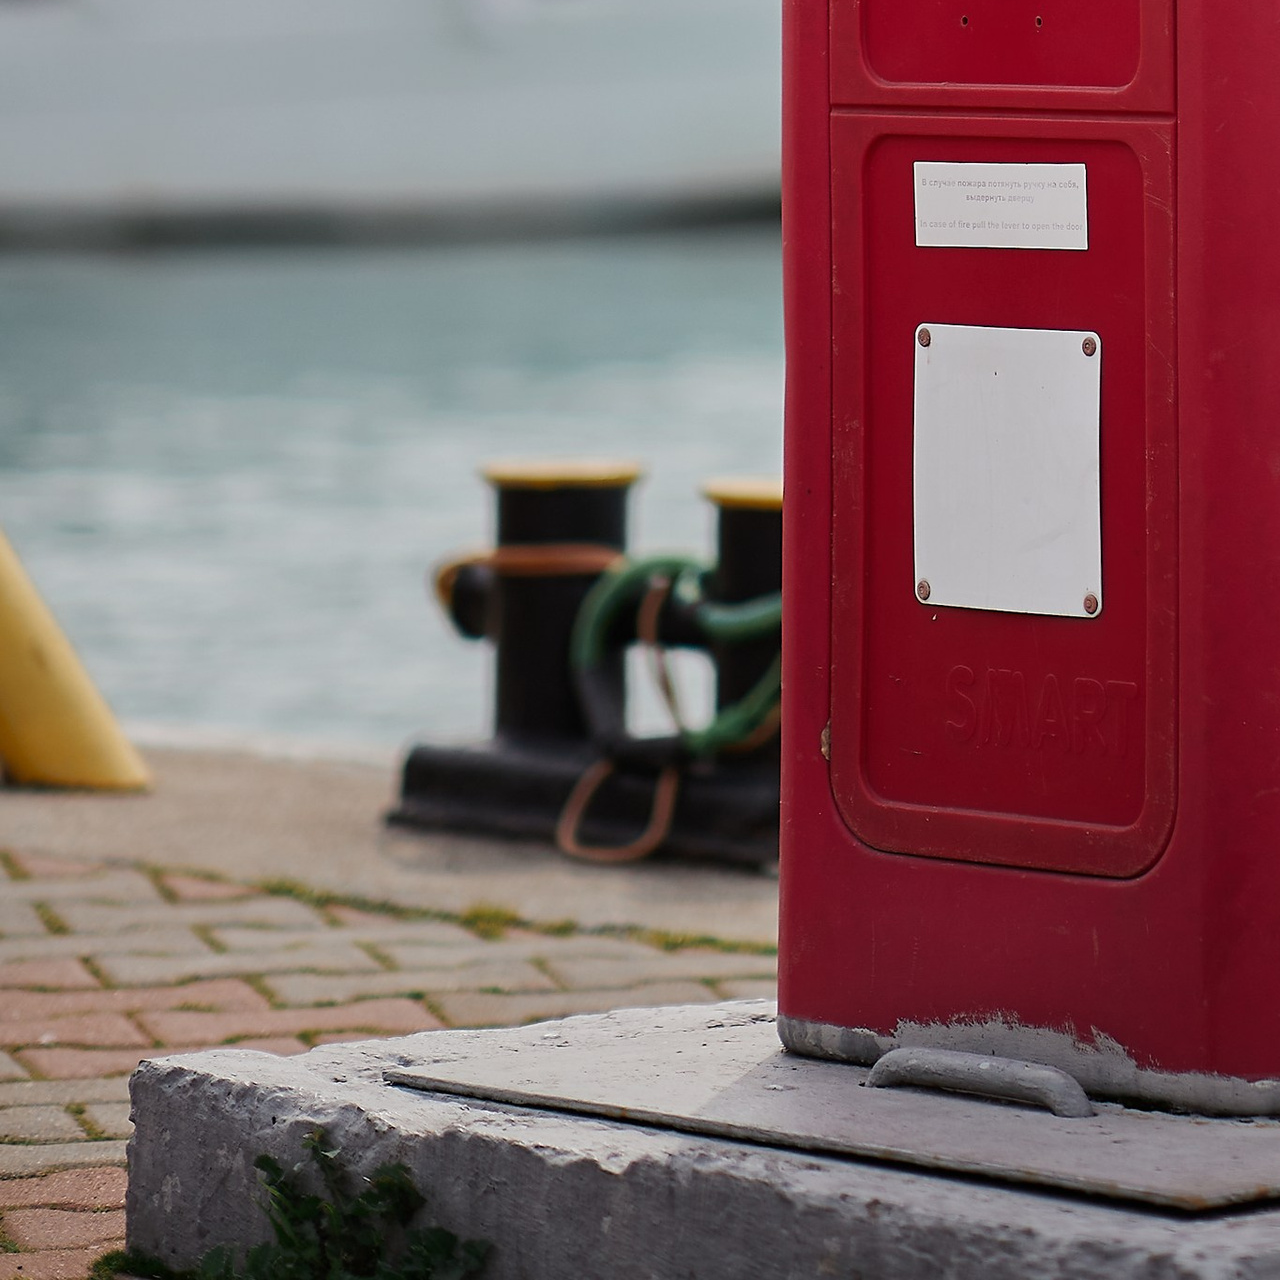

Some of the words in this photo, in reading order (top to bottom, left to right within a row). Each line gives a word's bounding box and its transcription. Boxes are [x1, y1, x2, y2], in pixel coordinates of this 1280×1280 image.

[921, 178, 927, 186] В
[929, 180, 956, 189] случае
[957, 180, 986, 189] пожара
[988, 181, 1022, 189] потянуть
[1023, 181, 1045, 190] ручку
[1059, 180, 1079, 189] себя,
[966, 194, 1006, 203] выдернуть
[1007, 195, 1035, 204] дверцу
[920, 220, 928, 228] In
[949, 220, 957, 228] of
[957, 220, 971, 229] fire
[972, 220, 986, 230] pull
[987, 221, 999, 229] the
[1001, 221, 1020, 230] lever
[1022, 222, 1030, 230] to
[1032, 223, 1050, 232] open
[1052, 222, 1064, 231] the
[1066, 222, 1083, 231] door
[945, 664, 1138, 757] SMART
